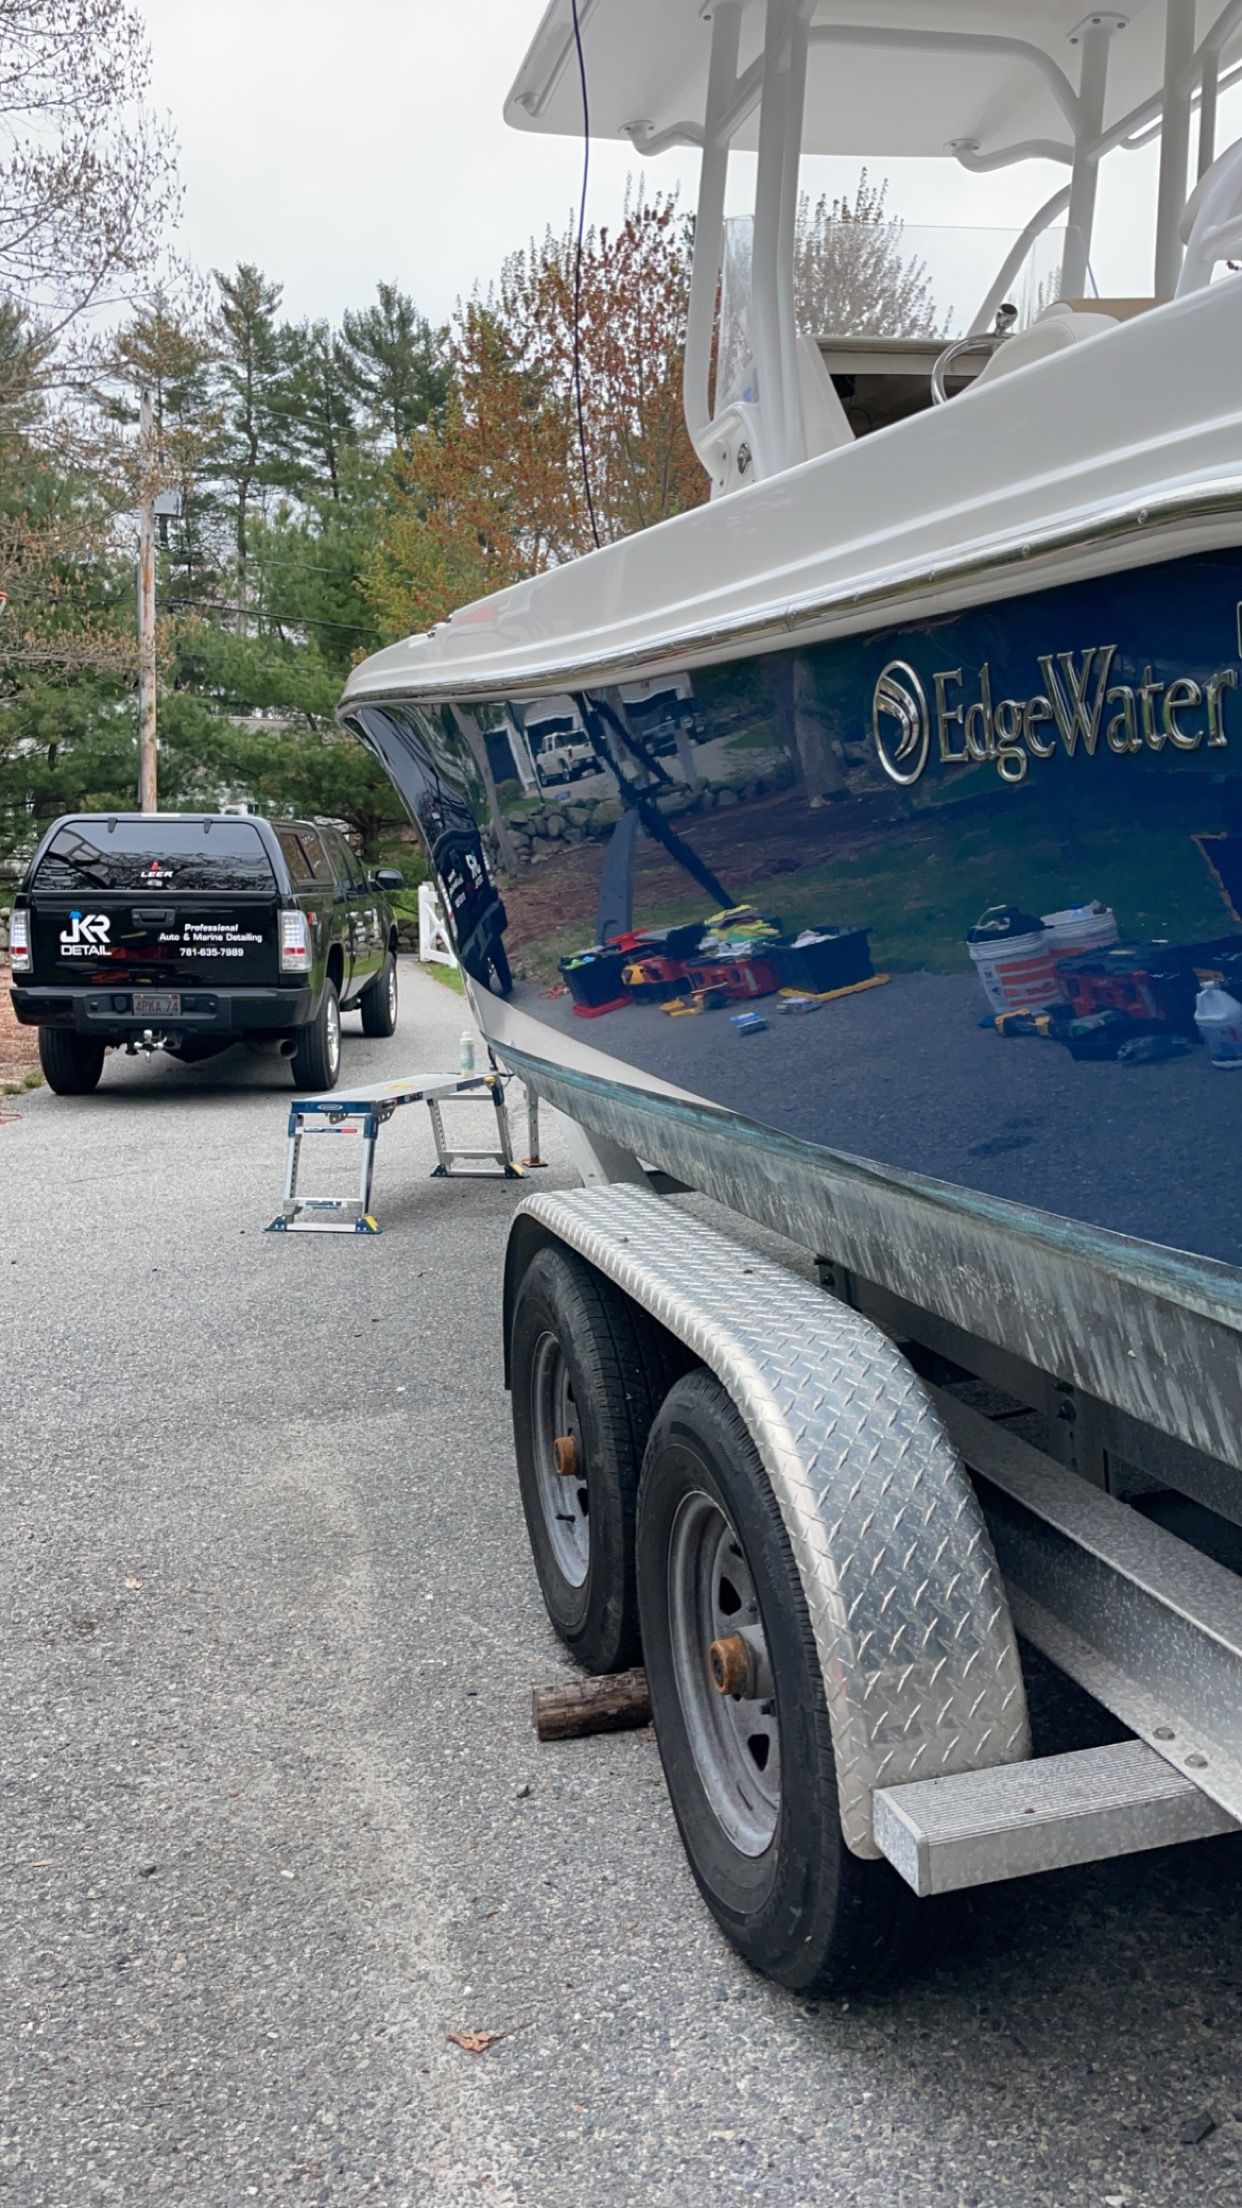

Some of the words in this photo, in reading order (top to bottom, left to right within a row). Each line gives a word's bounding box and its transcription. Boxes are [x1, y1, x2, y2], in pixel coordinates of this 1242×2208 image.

[932, 644, 1238, 782] EdgeWater
[60, 911, 111, 943] JKR
[184, 923, 239, 932] Professional
[159, 932, 180, 941] Auto
[183, 933, 190, 941] &
[193, 933, 223, 941] Marine
[225, 933, 263, 943] Detailing
[61, 944, 112, 956] DETAIL
